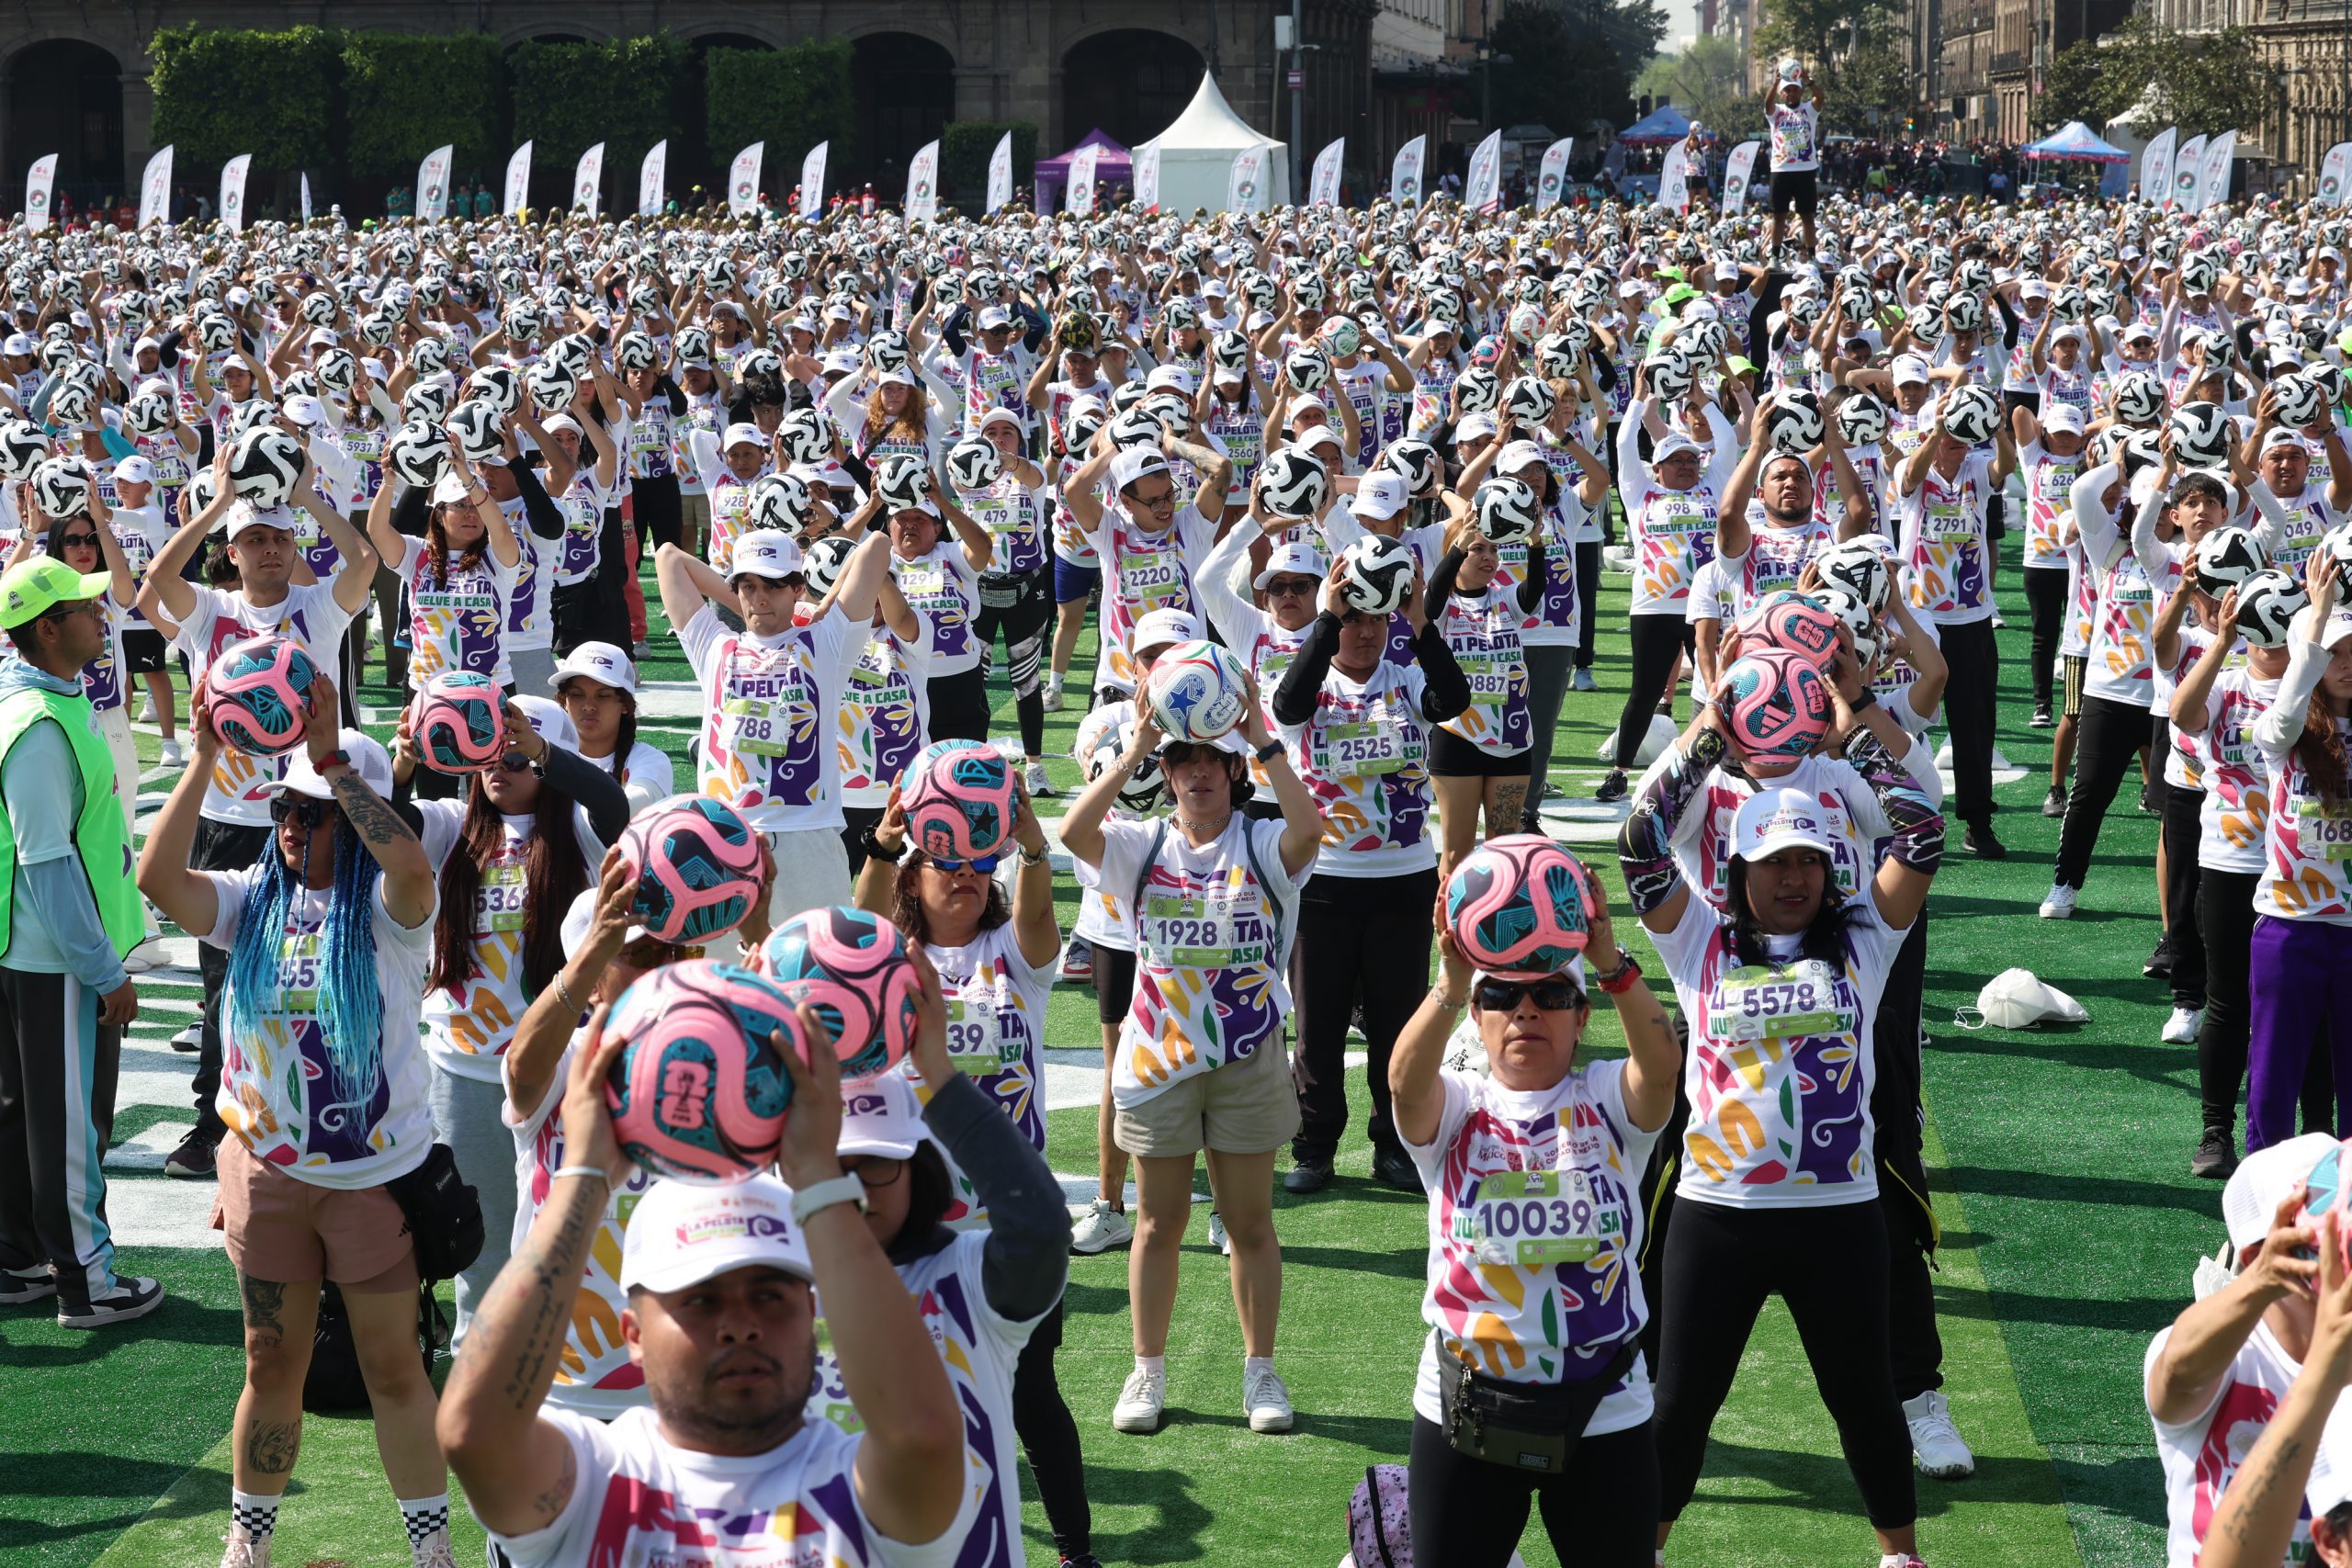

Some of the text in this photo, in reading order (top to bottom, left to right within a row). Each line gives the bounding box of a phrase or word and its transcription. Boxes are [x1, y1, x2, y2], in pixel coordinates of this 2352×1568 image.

[988, 372, 1011, 384] 3084
[346, 441, 373, 453] 5937
[1228, 447, 1253, 458] 2560
[1664, 503, 1691, 515] 998
[984, 510, 1008, 524] 479
[1646, 524, 1684, 534] VUELVE
[1686, 524, 1694, 532] A
[1933, 517, 1966, 532] 2791
[1129, 566, 1171, 587] 2220
[416, 595, 492, 607] VUELVE A CASA
[2114, 589, 2153, 600] VUELVE
[932, 599, 960, 610] CASA
[1466, 633, 1521, 652] PELOTA
[875, 689, 908, 703] CASA
[734, 716, 772, 741] 788
[1340, 737, 1393, 761] 2525
[1156, 919, 1218, 947] 1928
[1743, 983, 1817, 1018] 5578
[1478, 1199, 1592, 1238] 10039
